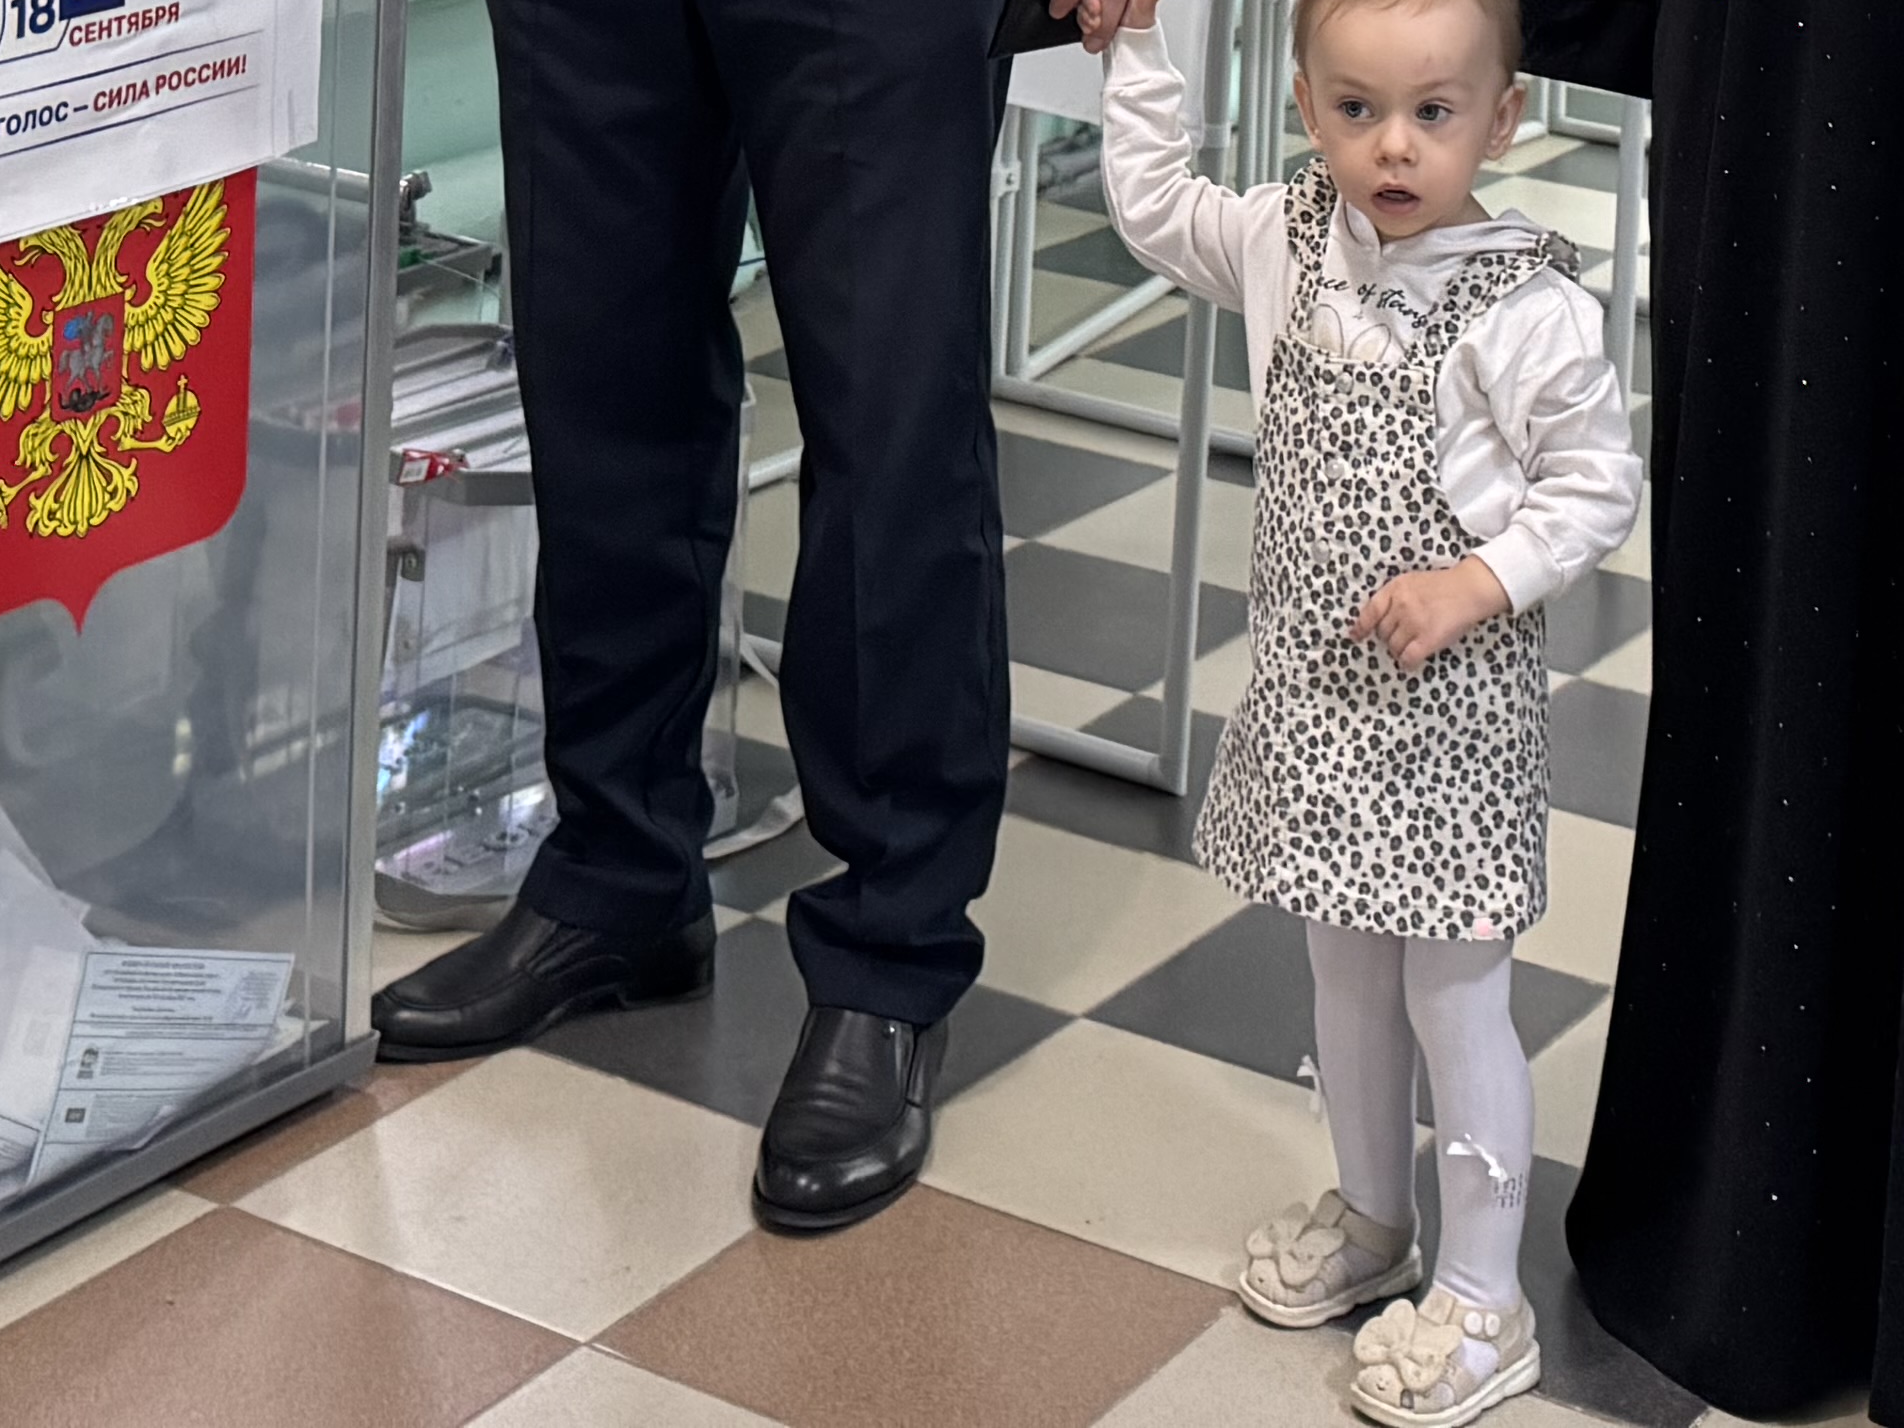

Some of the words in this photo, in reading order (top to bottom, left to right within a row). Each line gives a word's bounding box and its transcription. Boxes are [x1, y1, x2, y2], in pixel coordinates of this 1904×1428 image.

[69, 2, 180, 47] СЕНТЯБРЯ
[93, 81, 150, 113] СИЛА
[155, 54, 248, 97] РОССИИ!
